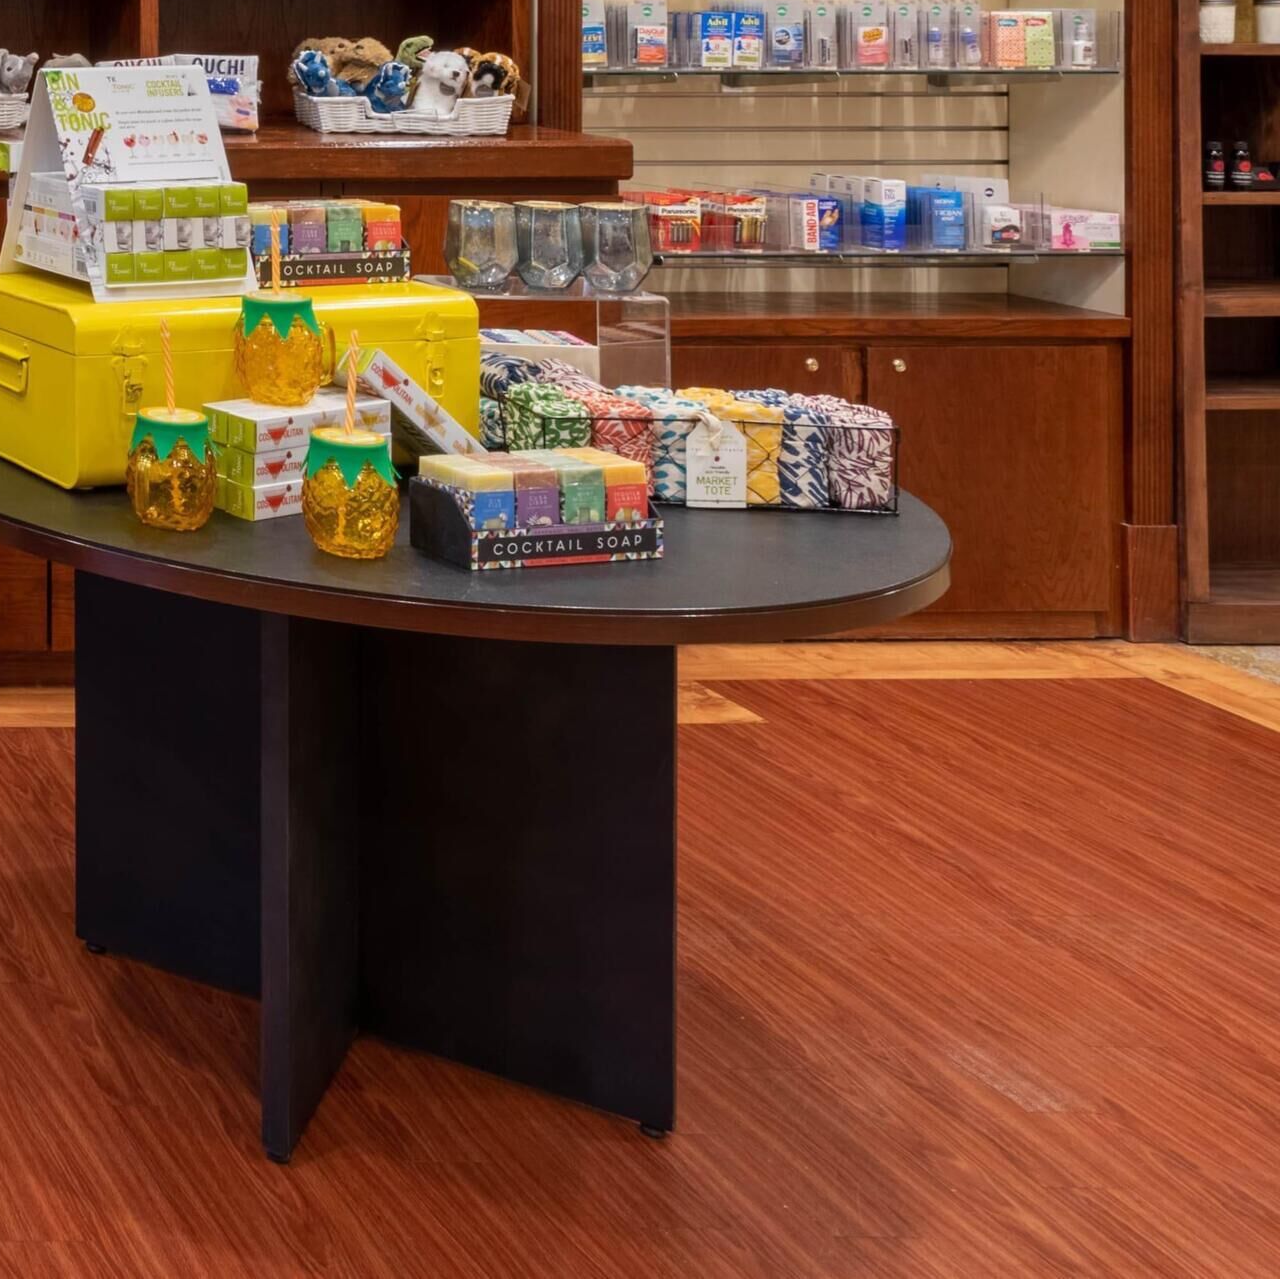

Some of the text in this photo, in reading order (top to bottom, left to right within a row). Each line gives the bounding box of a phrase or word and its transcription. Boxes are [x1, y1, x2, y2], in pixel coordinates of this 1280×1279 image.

[146, 80, 182, 88] COCKTAIL
[147, 88, 184, 97] INFUSERS
[57, 111, 112, 132] TONIC
[661, 207, 697, 215] Panasonic
[283, 261, 393, 276] OCKTAIL SOAP
[696, 476, 737, 486] MARKET
[705, 486, 732, 495] TOTE
[493, 535, 643, 556] COCKTAIL SOAP
